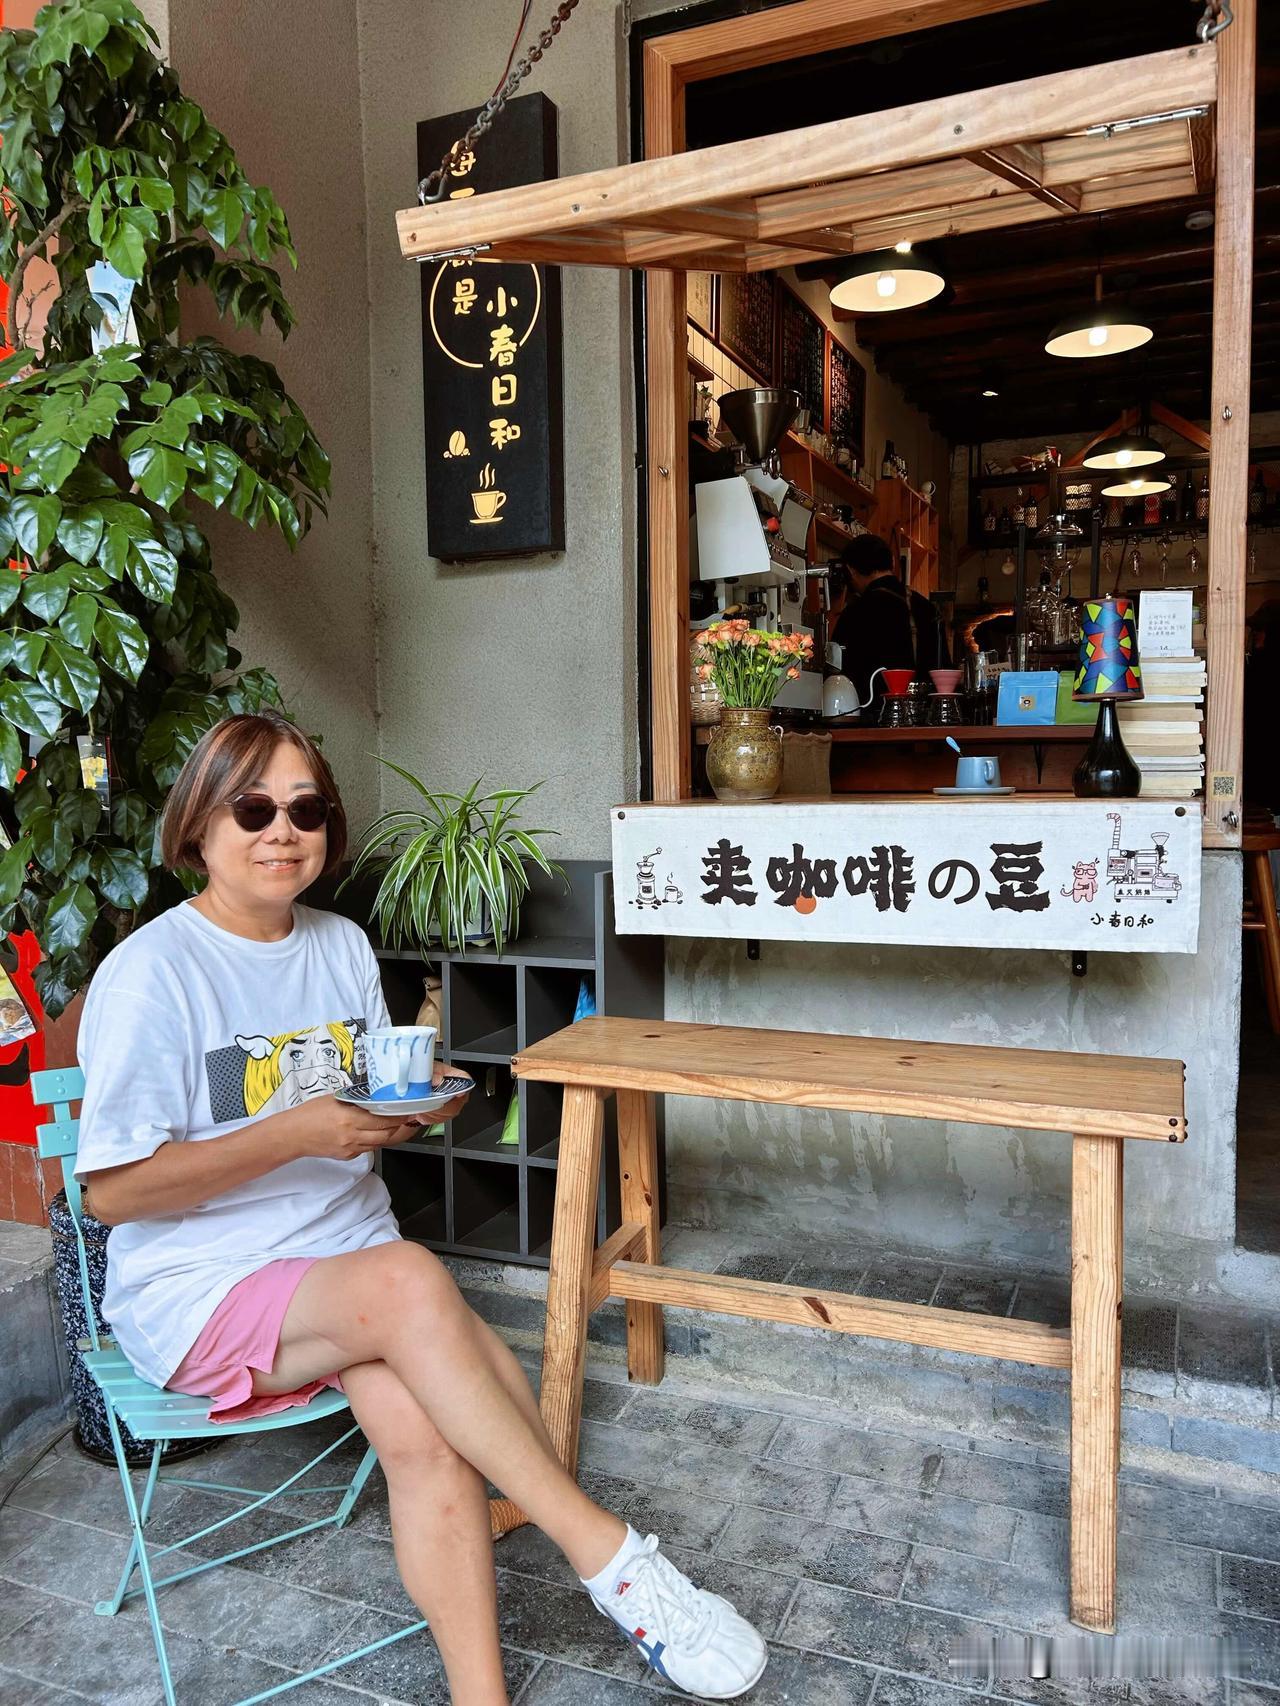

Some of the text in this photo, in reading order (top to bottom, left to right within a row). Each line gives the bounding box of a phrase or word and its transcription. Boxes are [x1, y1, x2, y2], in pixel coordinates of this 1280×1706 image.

[486, 286, 521, 450] 小春日和
[1090, 910, 1154, 928] 小春日和
